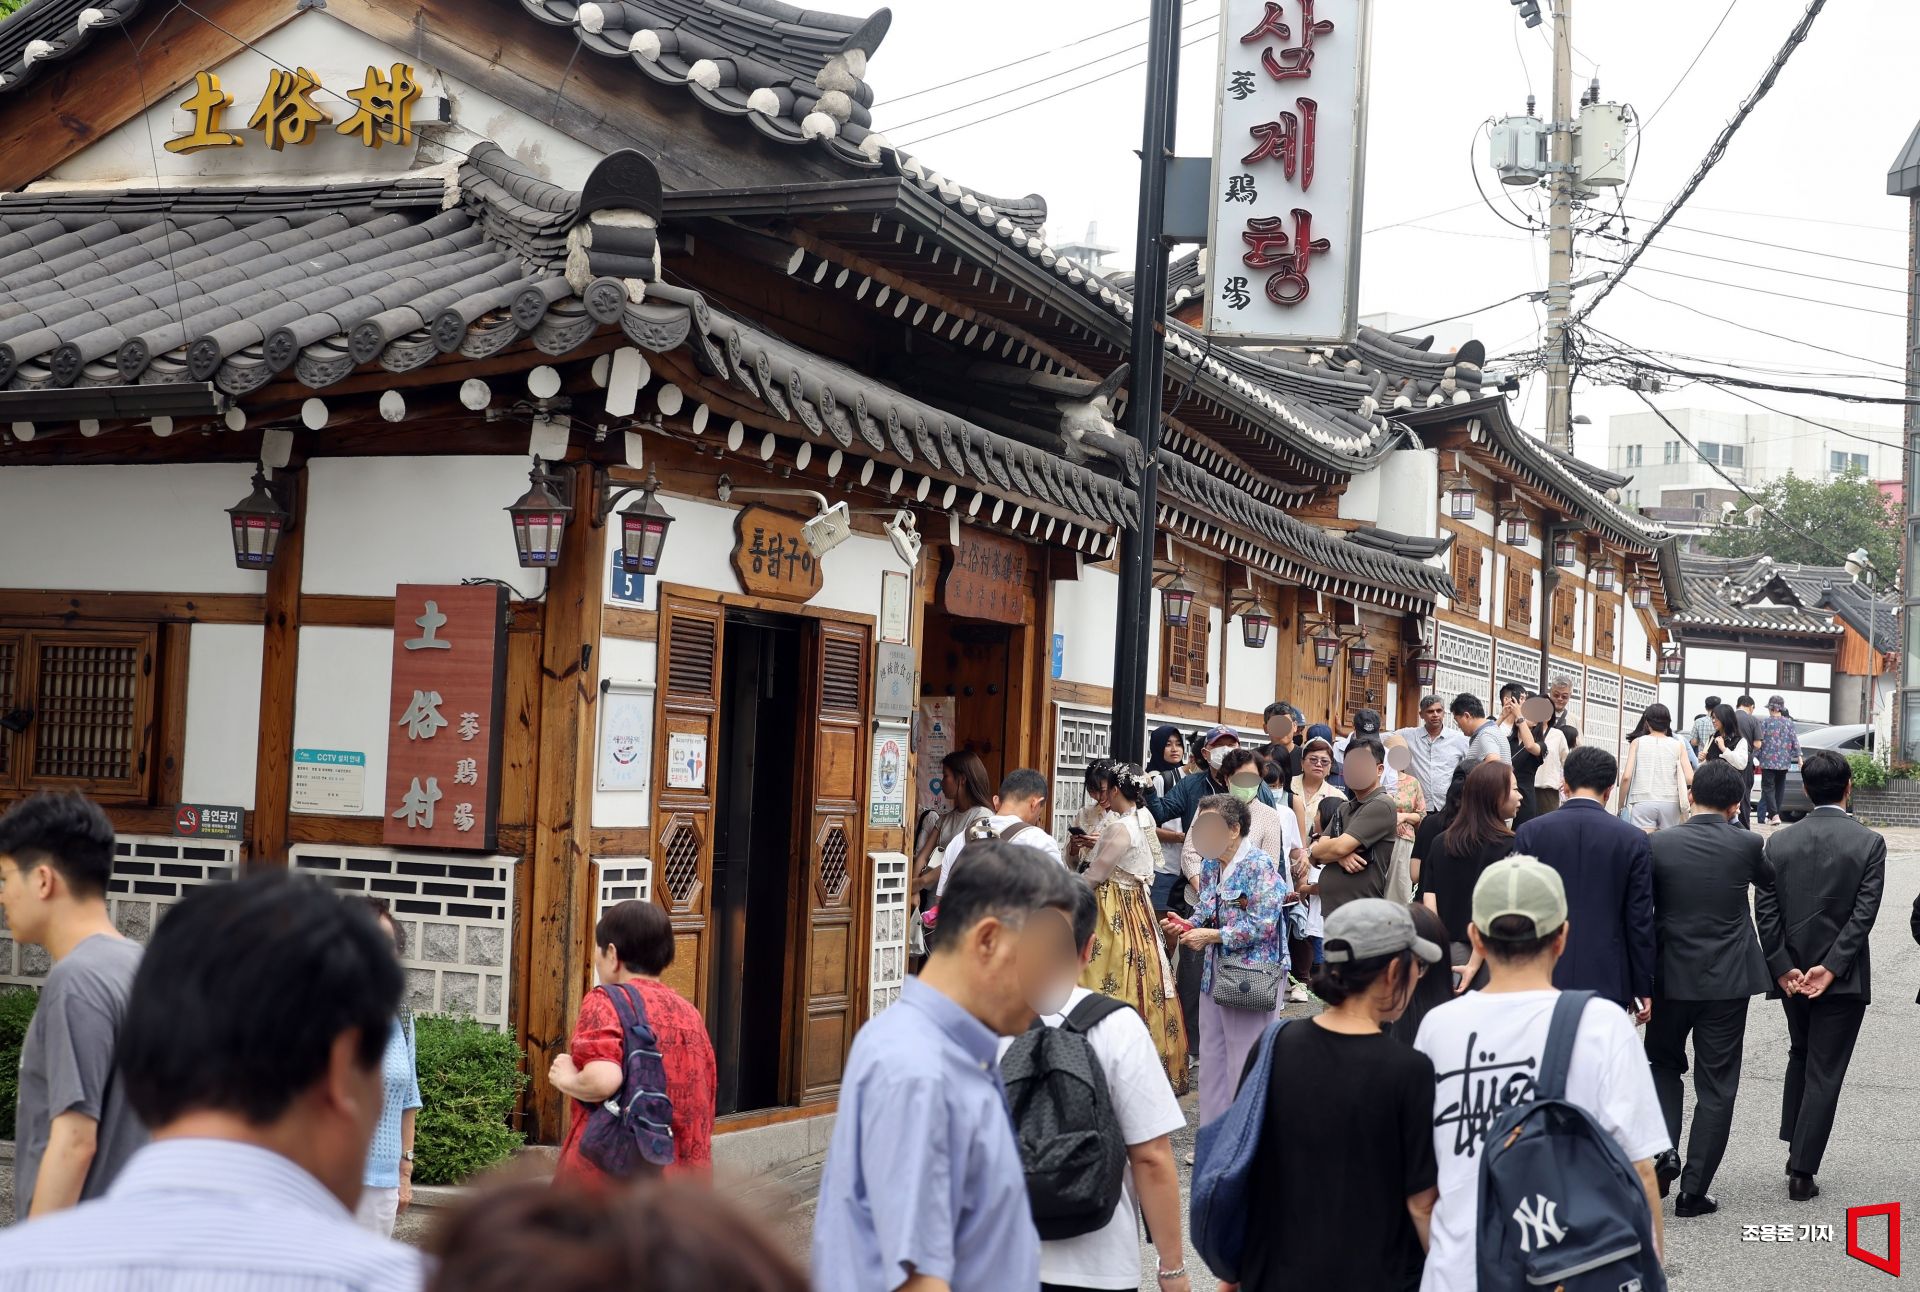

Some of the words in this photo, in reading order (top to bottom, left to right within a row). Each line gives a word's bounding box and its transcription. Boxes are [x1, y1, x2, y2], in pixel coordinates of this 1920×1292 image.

[164, 63, 422, 155] 土俗村
[1240, 0, 1335, 306] 삼계탕
[624, 573, 633, 596] 5
[392, 600, 452, 829] 土俗村
[317, 753, 337, 762] CCTV
[201, 809, 238, 824] 흡연금지
[873, 804, 900, 816] 모범음식점
[1512, 1194, 1567, 1253] NY
